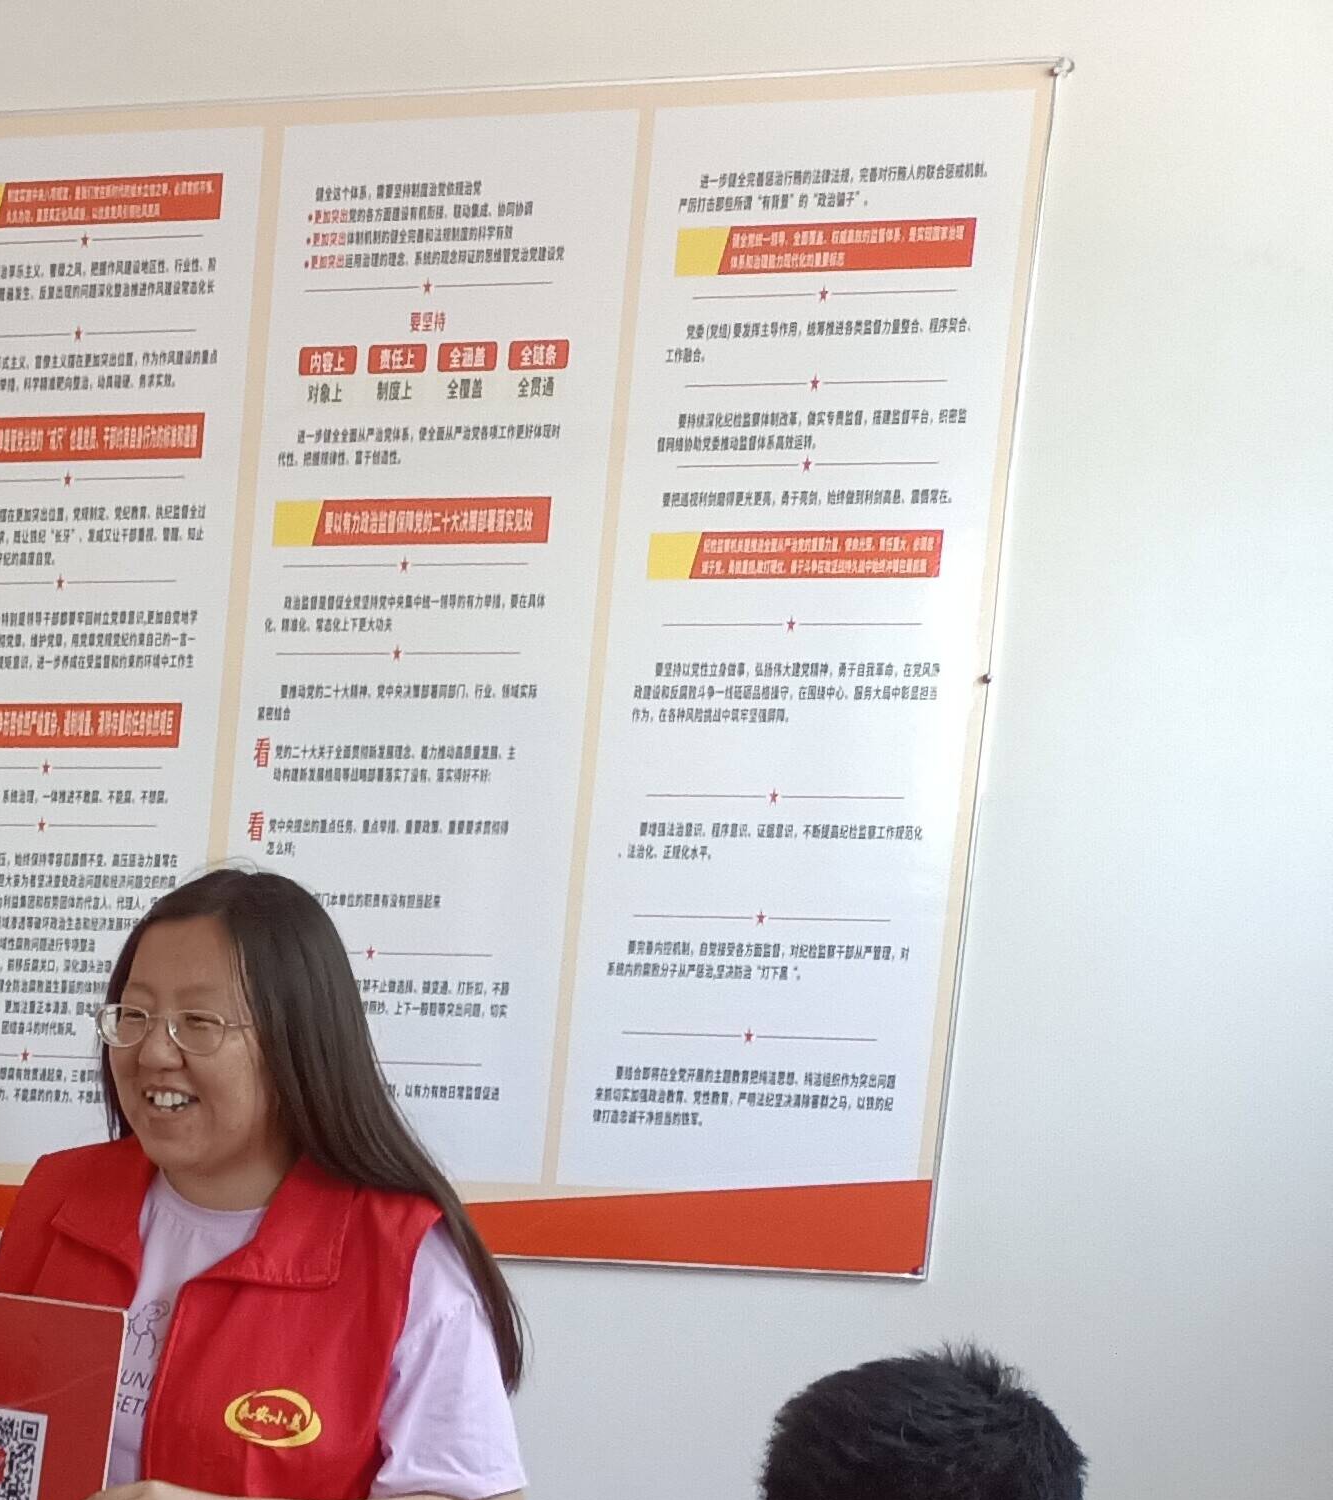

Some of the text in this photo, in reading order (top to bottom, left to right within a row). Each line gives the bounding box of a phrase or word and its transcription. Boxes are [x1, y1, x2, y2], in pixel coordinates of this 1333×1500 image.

[409, 311, 447, 333] 要坚持
[309, 351, 345, 372] 内容上
[378, 349, 416, 371] 责任上
[306, 377, 555, 403] 对象上 制度上 全覆盖 全贯通
[253, 738, 271, 768] 看
[247, 811, 264, 841] 看
